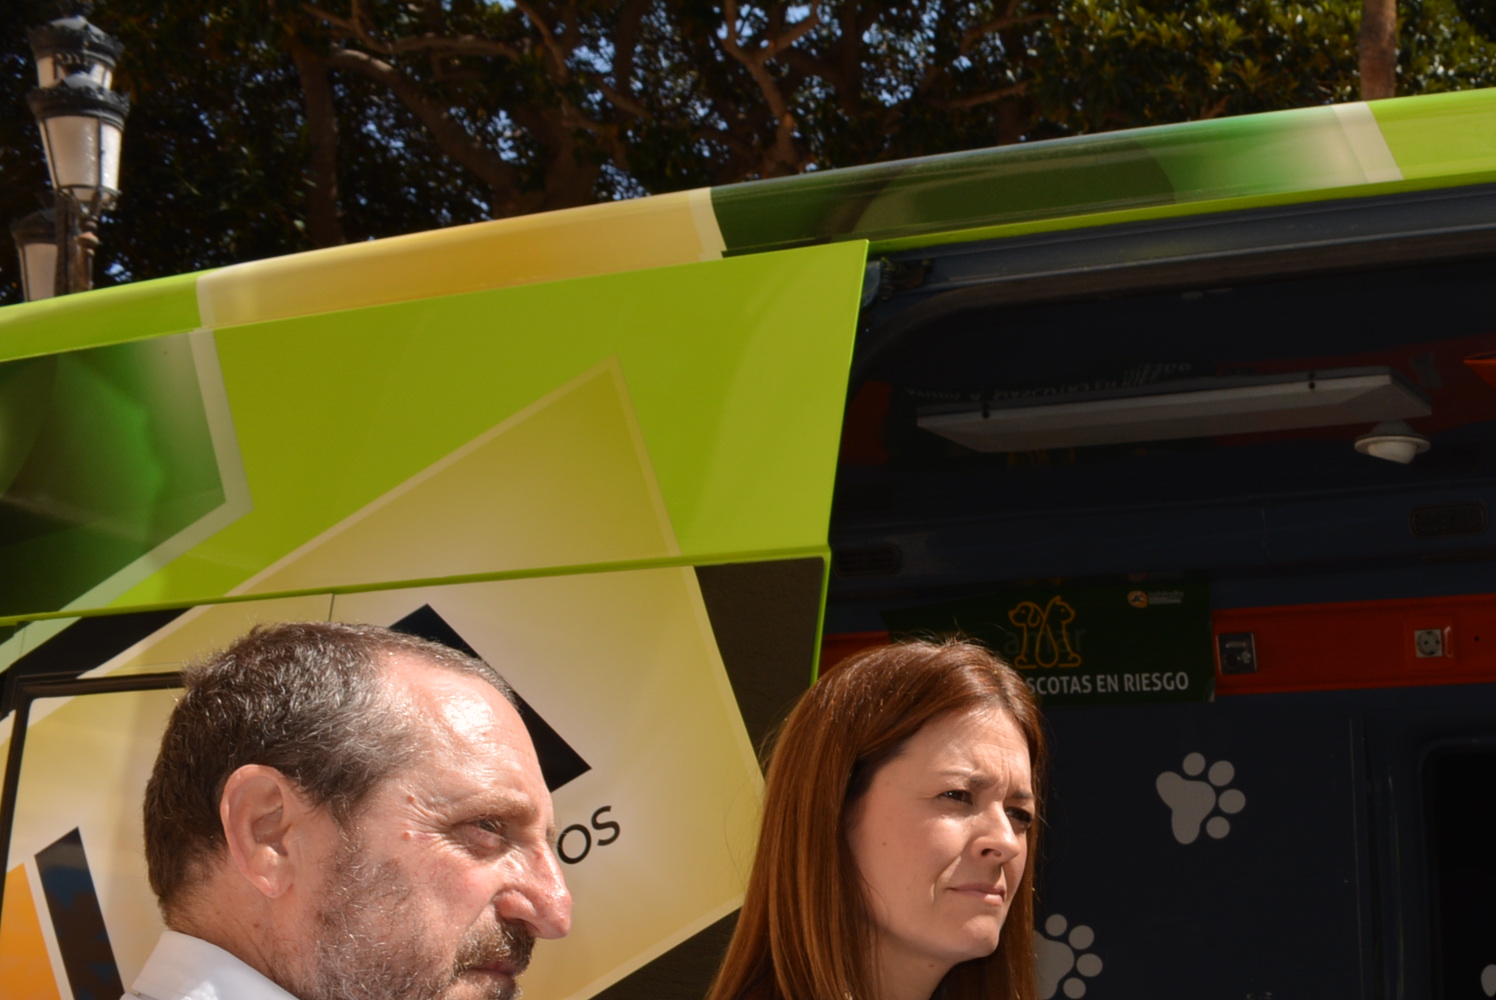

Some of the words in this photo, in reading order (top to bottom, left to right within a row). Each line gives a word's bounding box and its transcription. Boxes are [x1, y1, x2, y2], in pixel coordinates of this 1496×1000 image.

[1026, 675, 1092, 695] SCOTAS
[1096, 674, 1119, 693] EN
[1124, 671, 1189, 692] RIESGO
